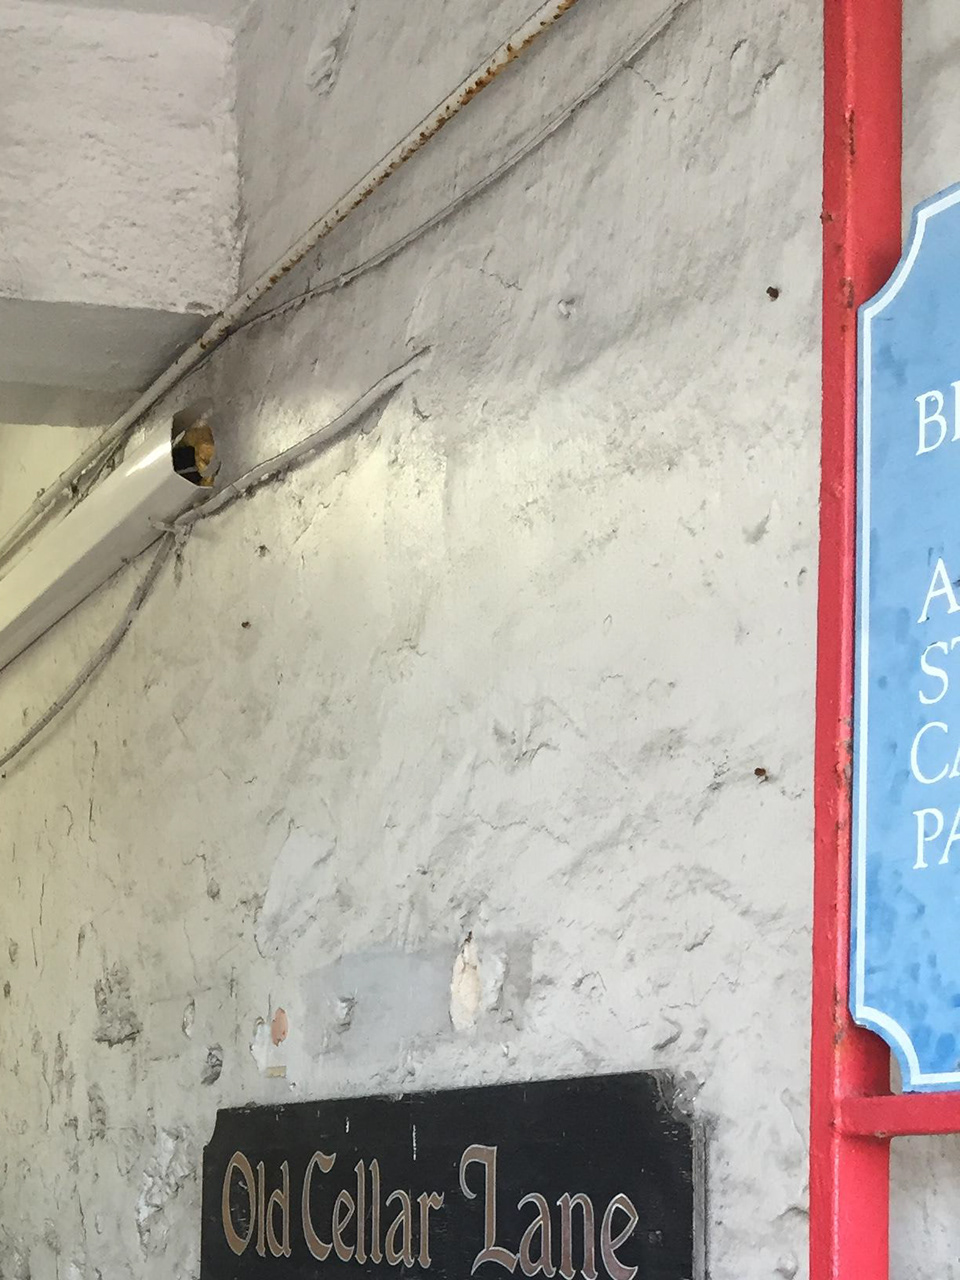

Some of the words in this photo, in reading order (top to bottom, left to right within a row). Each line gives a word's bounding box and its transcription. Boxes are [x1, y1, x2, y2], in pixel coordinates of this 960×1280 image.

[918, 635, 960, 705] S
[910, 721, 960, 785] C
[222, 1150, 292, 1258] Old
[301, 1150, 445, 1269] Cellar
